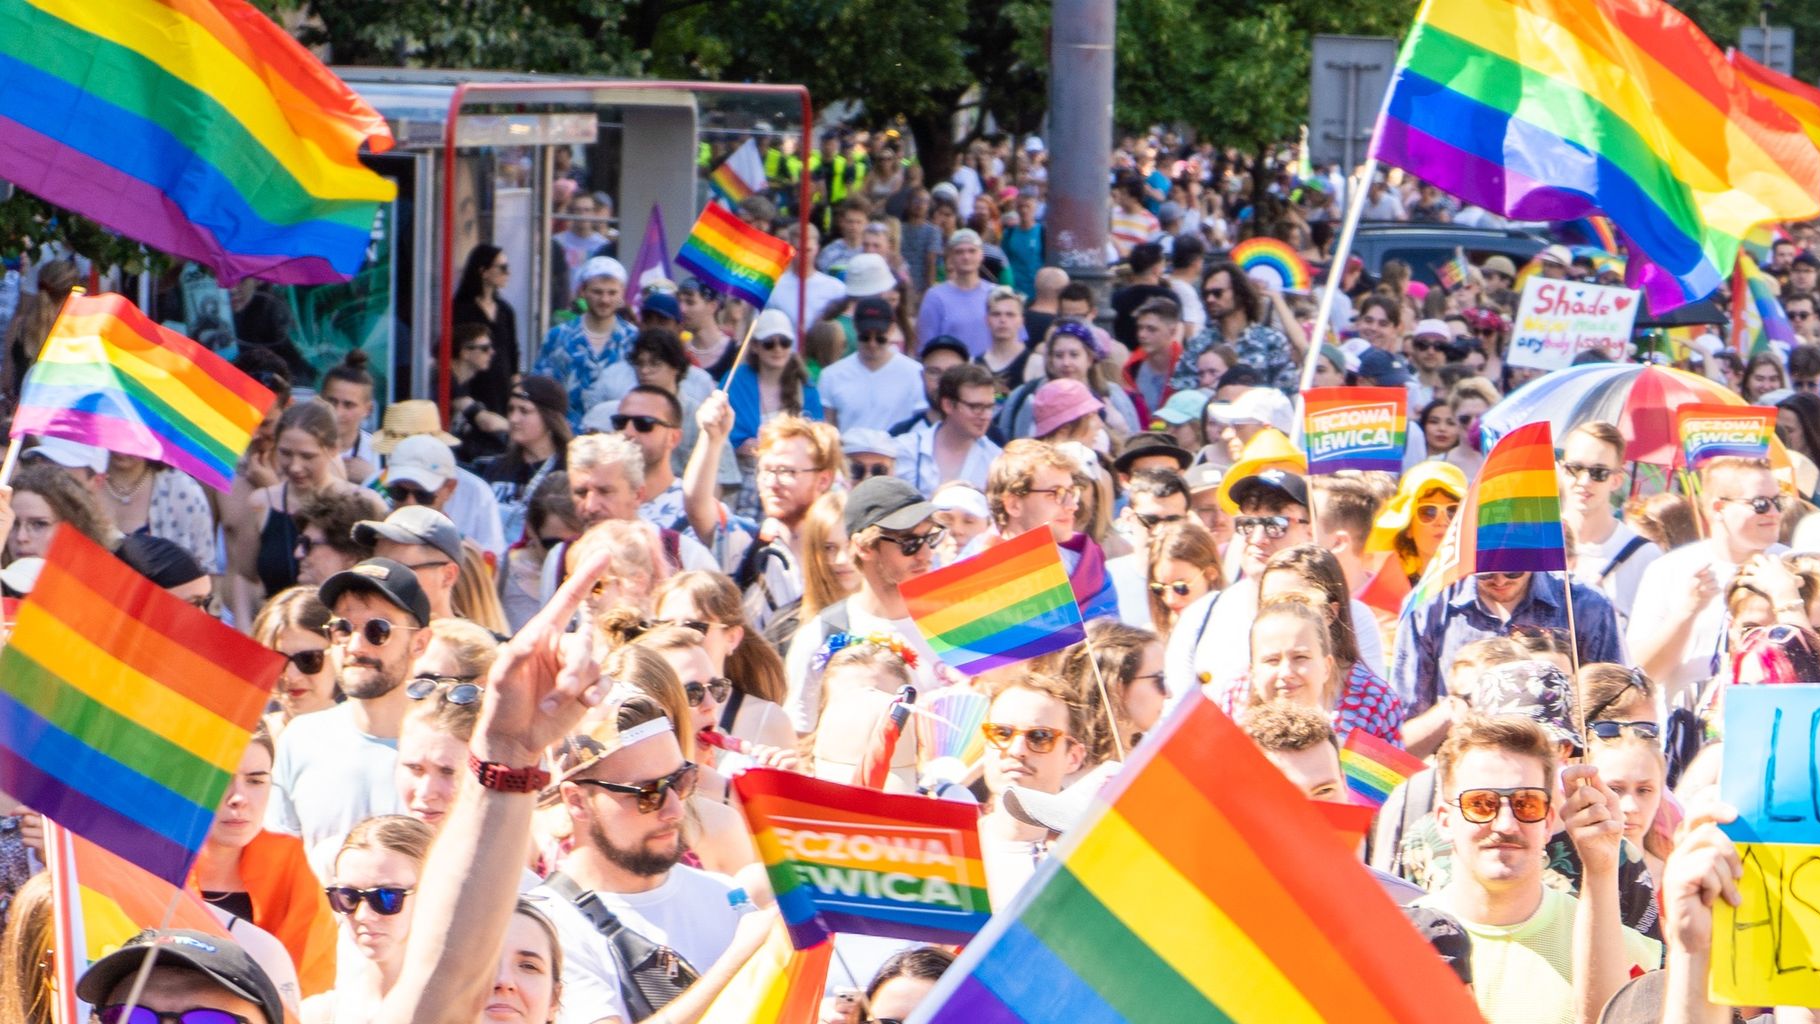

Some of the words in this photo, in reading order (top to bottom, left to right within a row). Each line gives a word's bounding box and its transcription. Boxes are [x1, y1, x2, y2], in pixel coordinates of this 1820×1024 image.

[1533, 283, 1611, 317] Shade
[1313, 407, 1393, 434] TĘCZOWA
[1314, 427, 1390, 455] LEWICA
[773, 826, 954, 866] ĘCZOWA
[791, 863, 963, 906] EWICA
